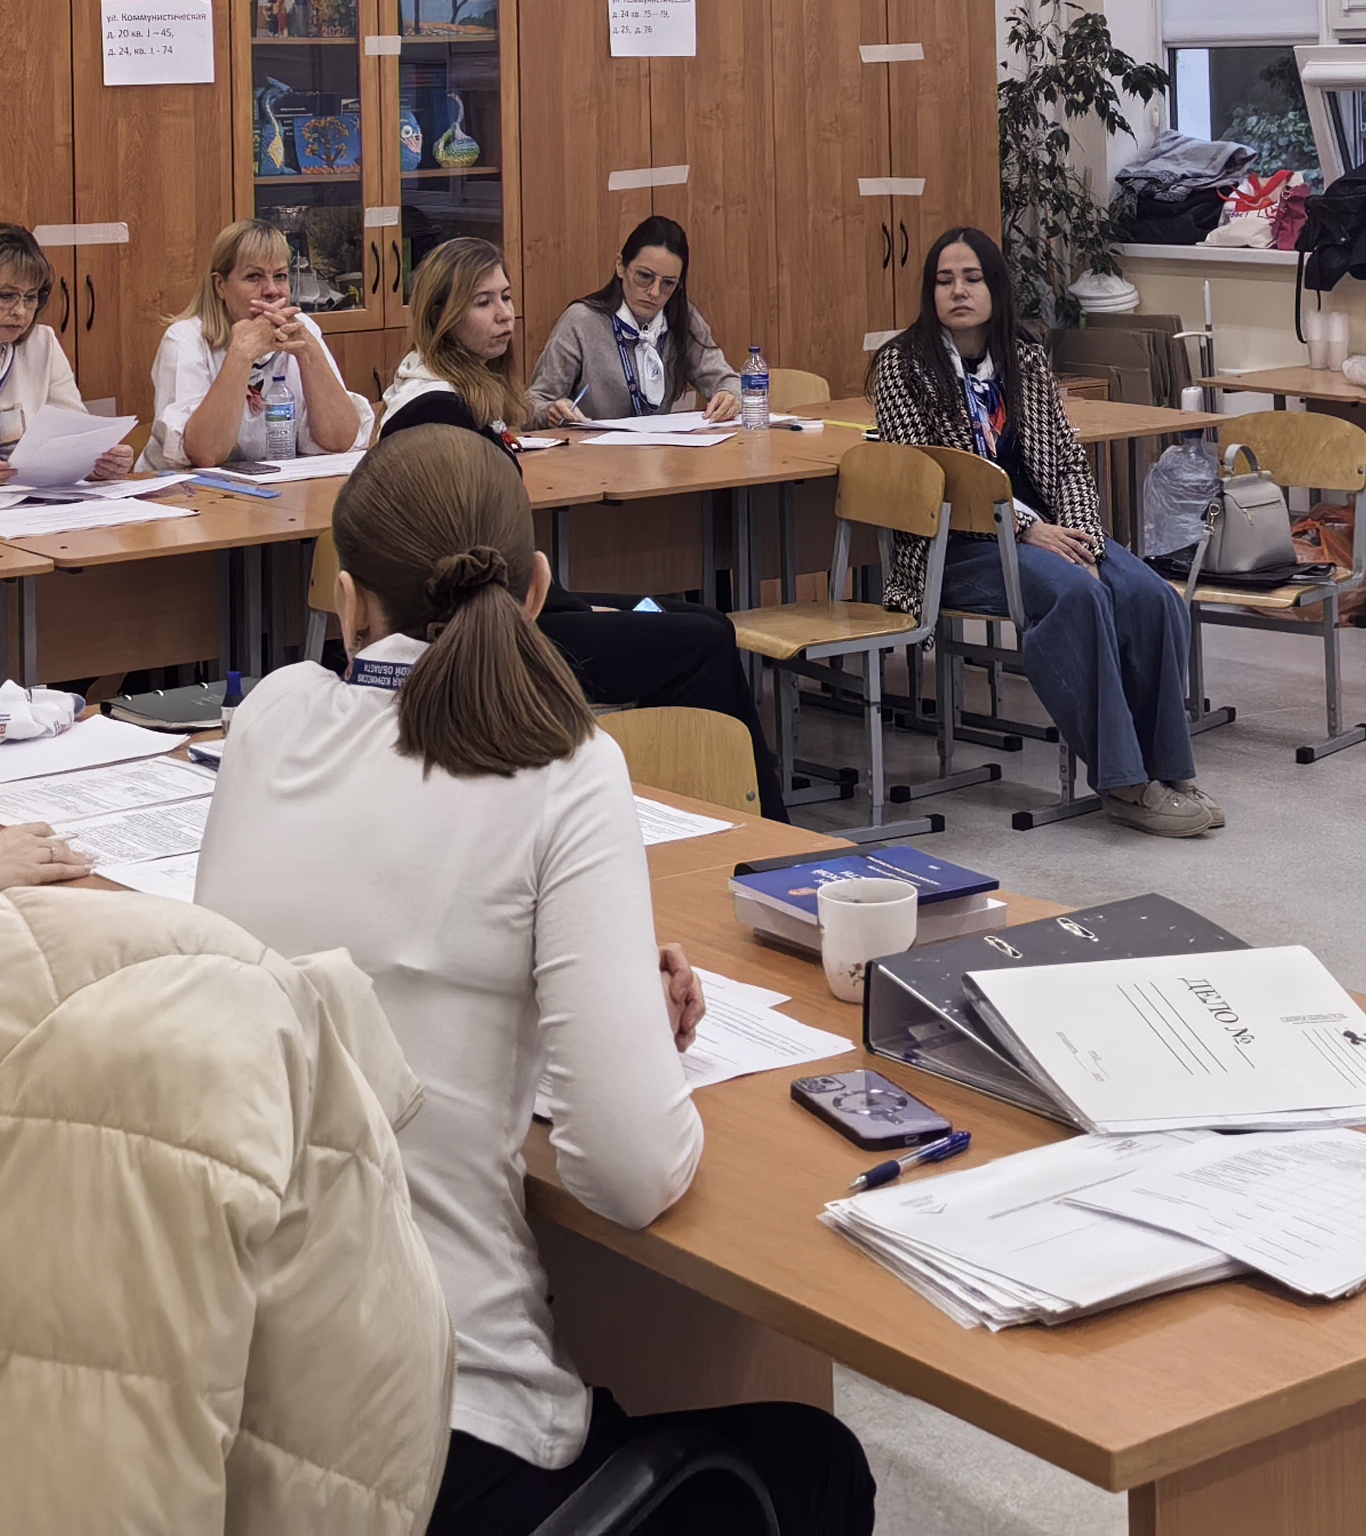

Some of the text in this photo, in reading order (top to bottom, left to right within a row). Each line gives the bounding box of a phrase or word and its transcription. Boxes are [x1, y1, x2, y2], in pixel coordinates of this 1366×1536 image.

[106, 13, 206, 23] ул. Коммунистическая
[106, 31, 115, 39] д.
[117, 29, 129, 38] 20
[160, 28, 174, 39] 45,
[107, 48, 116, 56] д.
[118, 46, 132, 56] 24,
[162, 45, 173, 55] 74
[364, 663, 393, 675] ОБЛАСТИ
[1177, 977, 1239, 1024] ДЕЛО
